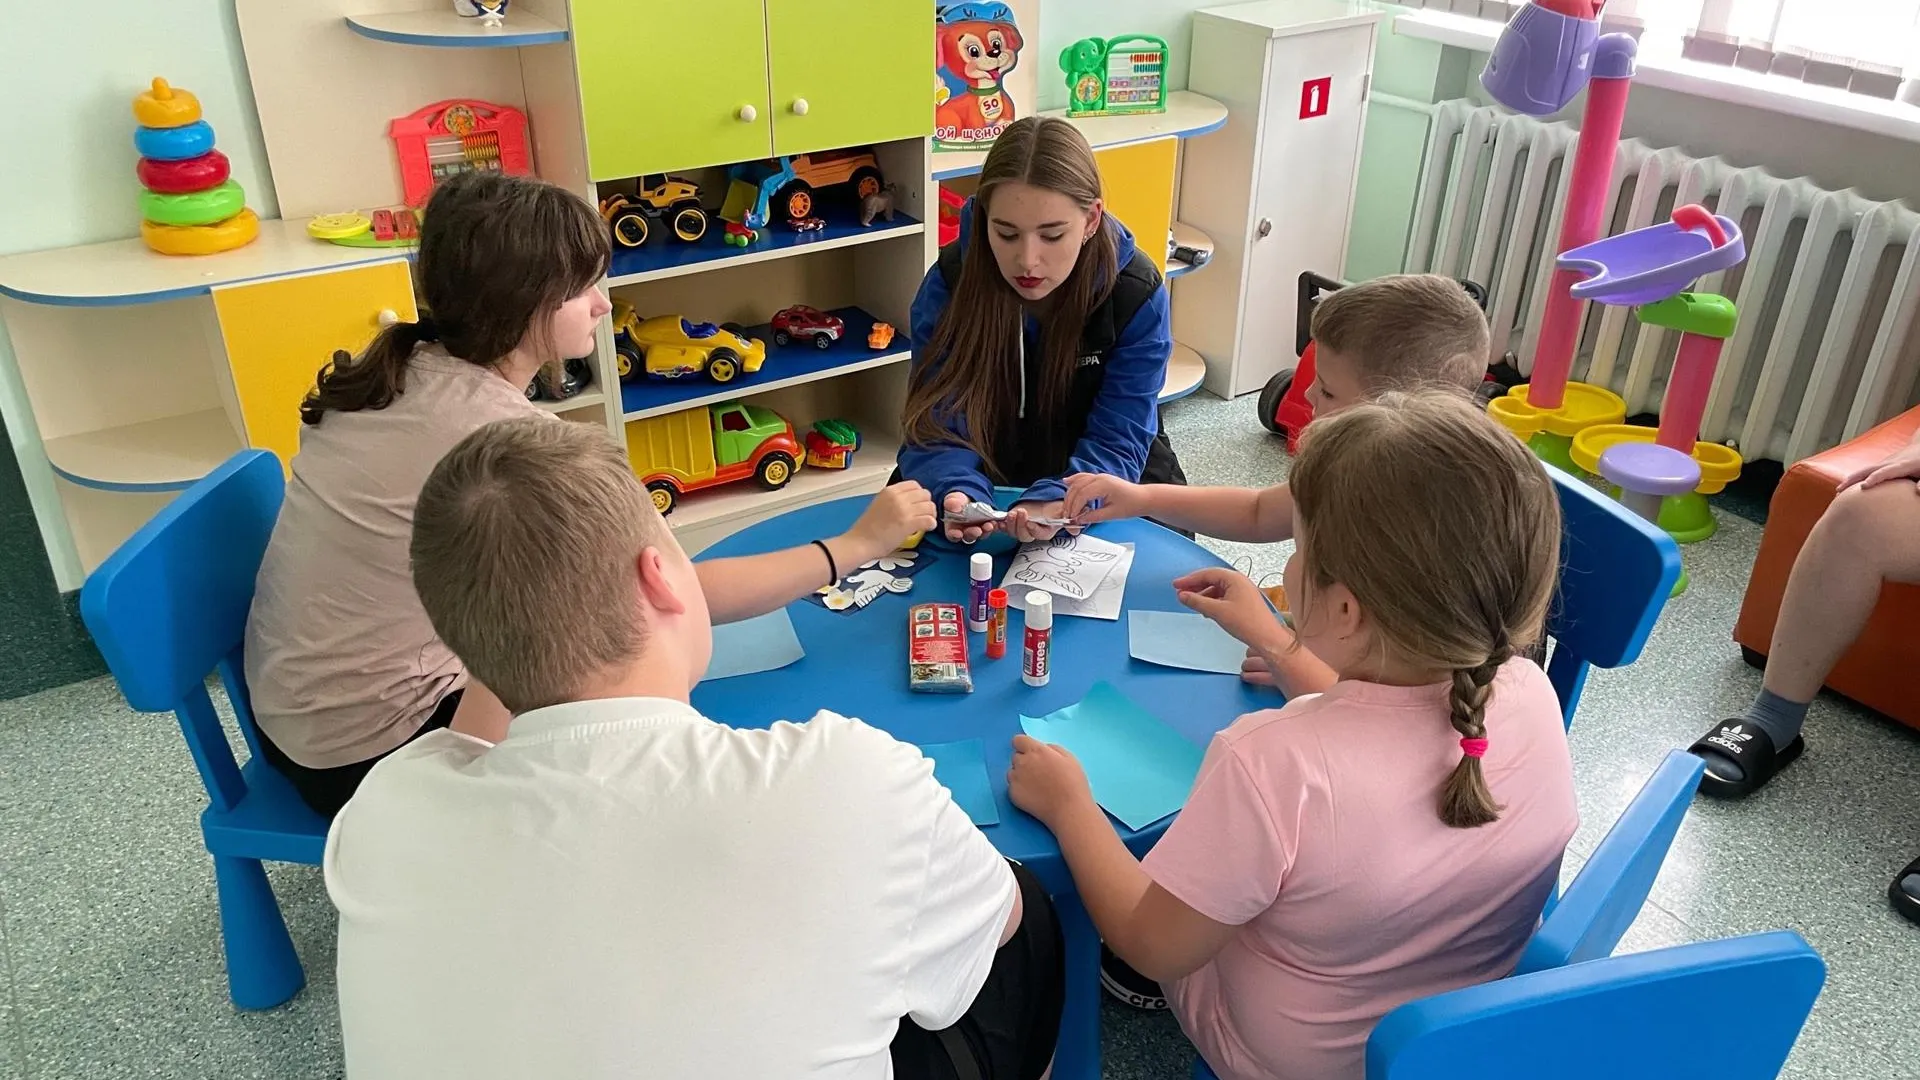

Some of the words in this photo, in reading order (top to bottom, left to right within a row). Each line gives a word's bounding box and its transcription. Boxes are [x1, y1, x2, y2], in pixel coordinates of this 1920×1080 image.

[983, 98, 999, 111] 50
[936, 125, 956, 139] ой
[1707, 736, 1743, 754] adidas
[1129, 994, 1167, 1009] cro
